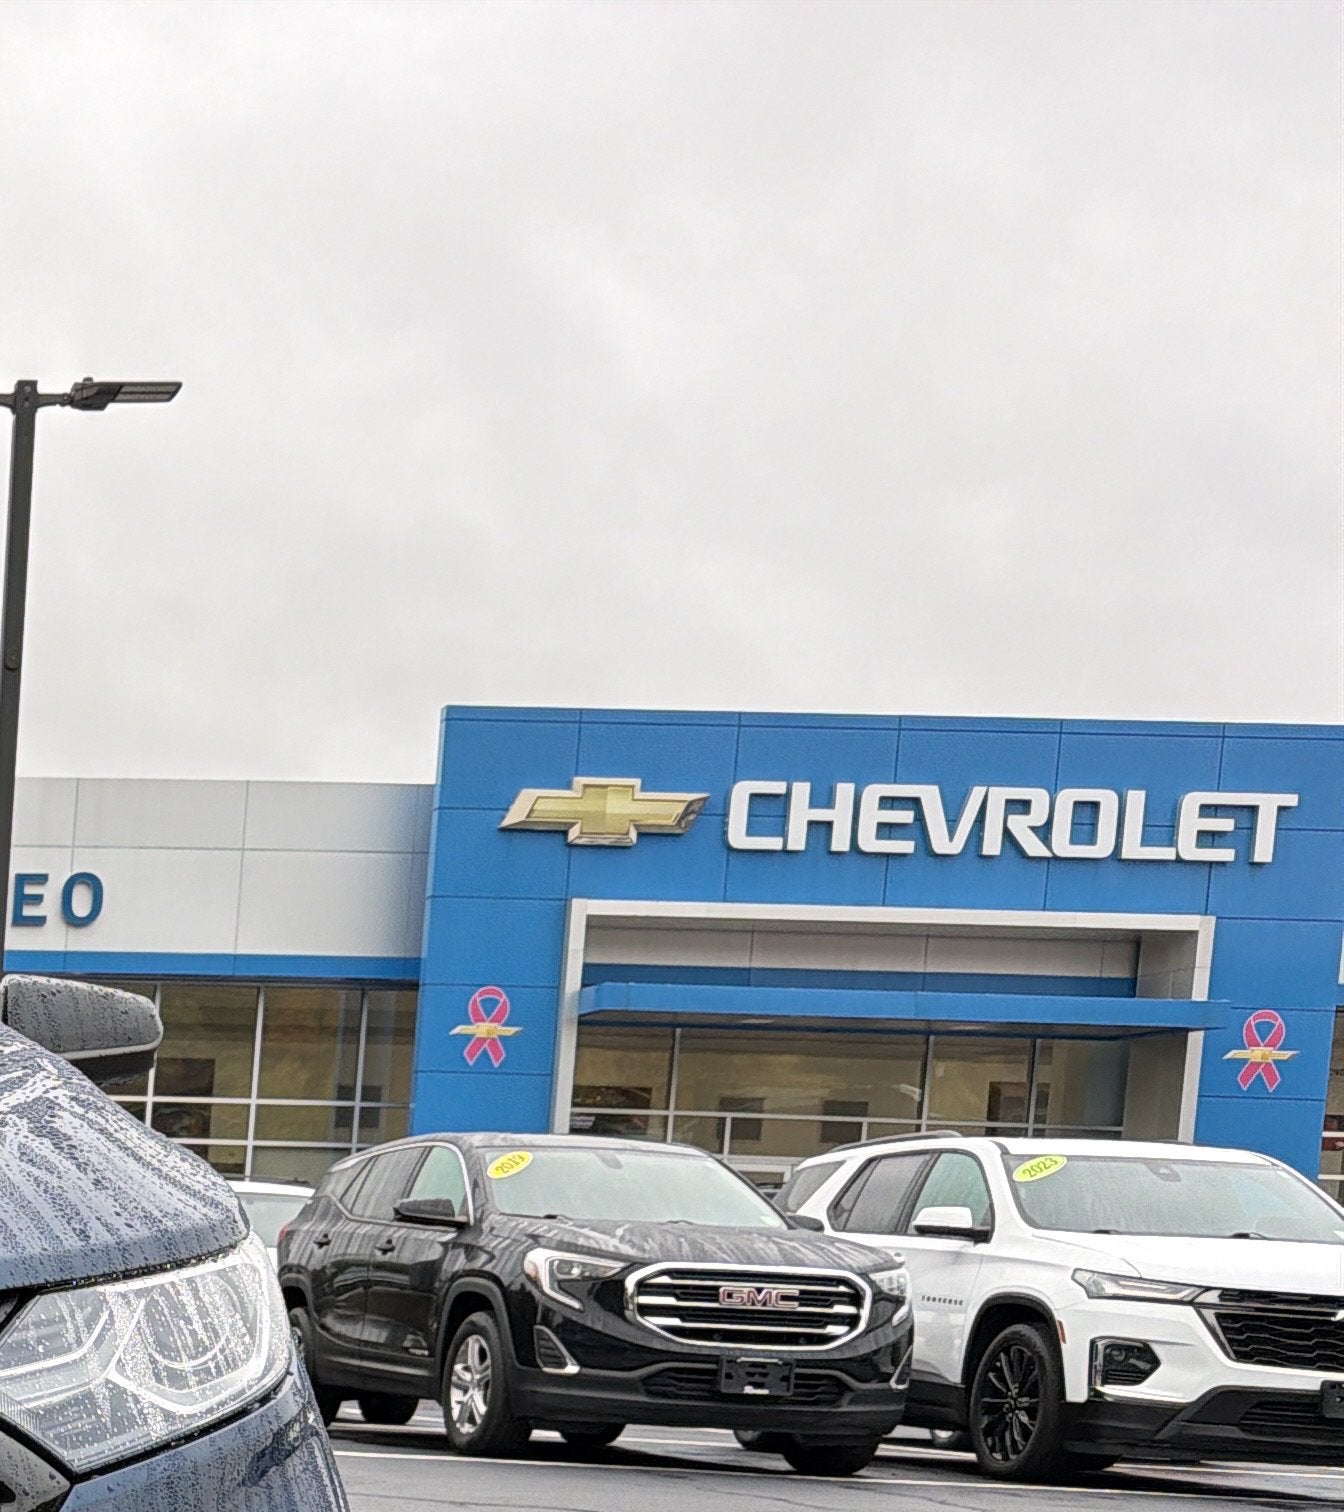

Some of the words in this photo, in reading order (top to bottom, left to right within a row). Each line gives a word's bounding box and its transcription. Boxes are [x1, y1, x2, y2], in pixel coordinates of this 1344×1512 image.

[726, 779, 1299, 864] CHEVROLET
[494, 1154, 525, 1174] 2019
[1021, 1157, 1059, 1178] 2023
[718, 1286, 800, 1309] GMC
